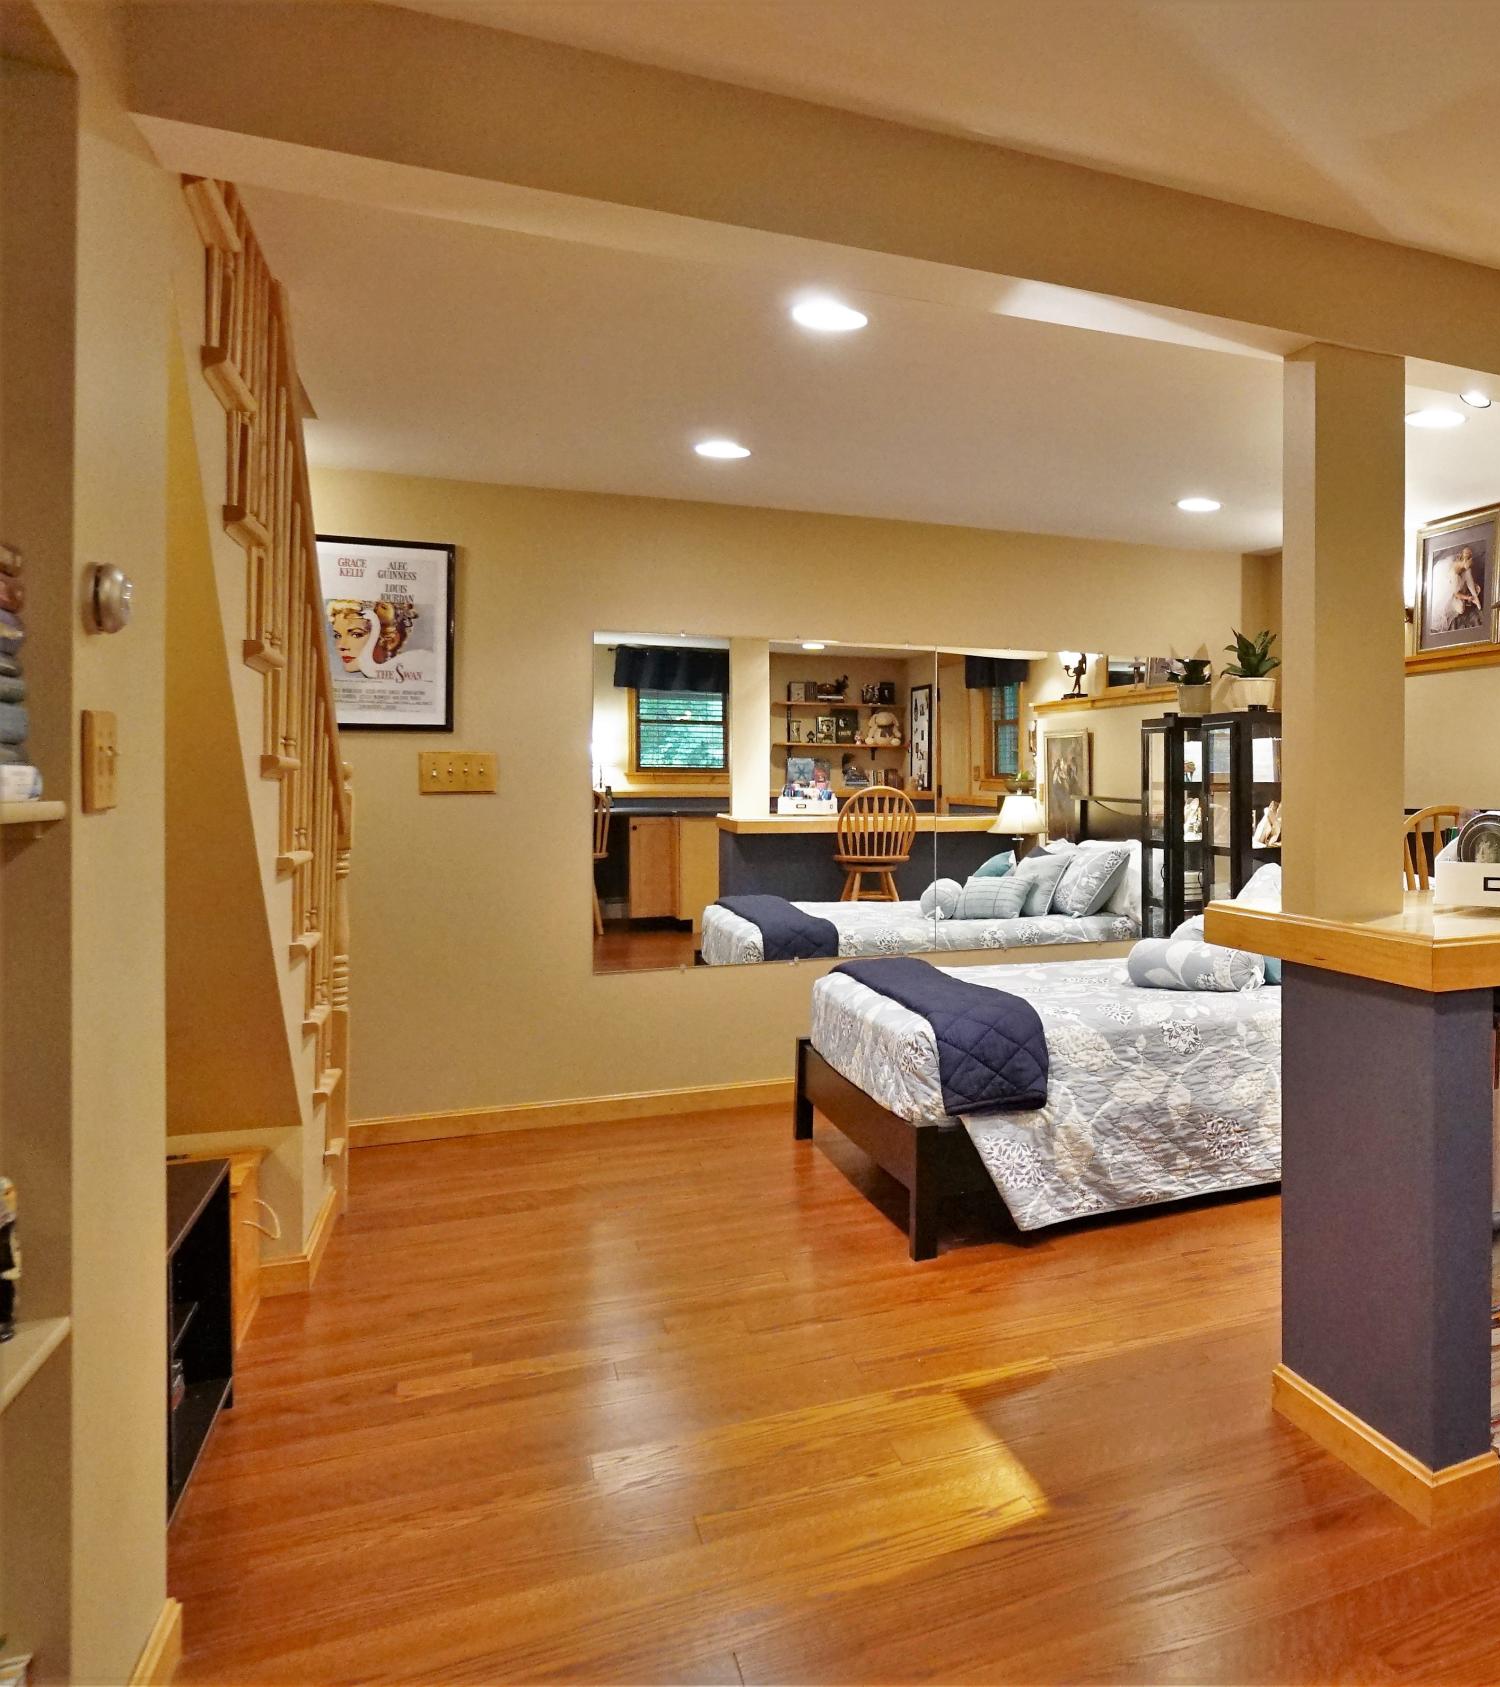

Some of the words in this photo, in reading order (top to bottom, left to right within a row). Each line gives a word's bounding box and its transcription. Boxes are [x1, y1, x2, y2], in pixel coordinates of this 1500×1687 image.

[337, 557, 367, 568] GRACE
[388, 561, 408, 571] ALEC
[339, 567, 365, 578] KELLY
[377, 570, 417, 581] GUINNESS
[385, 583, 408, 593] LOUIS
[376, 670, 395, 680] THE
